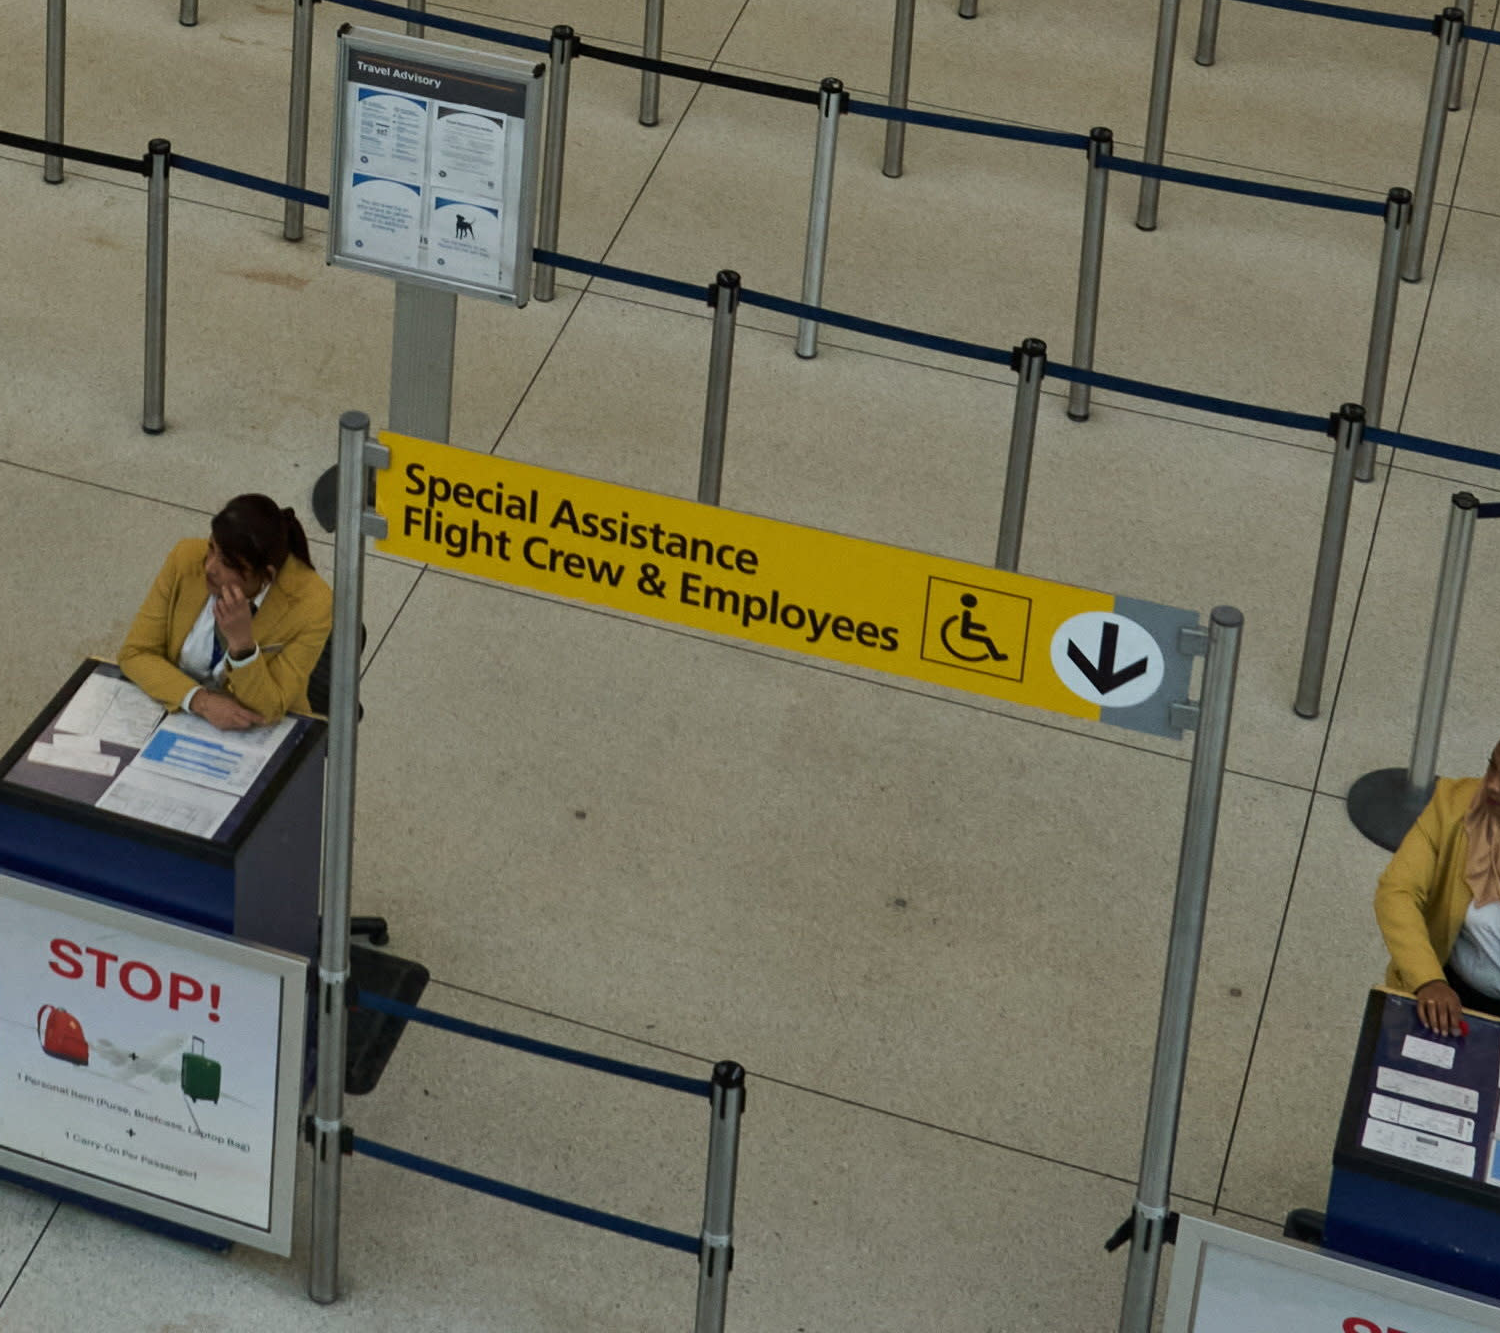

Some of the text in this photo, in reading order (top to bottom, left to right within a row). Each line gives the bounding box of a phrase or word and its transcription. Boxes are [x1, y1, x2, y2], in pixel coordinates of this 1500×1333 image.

[356, 59, 443, 90] Travel Advisory
[402, 460, 760, 579] Special Assistance
[401, 503, 900, 655] Flight Crew & Employees
[46, 935, 223, 1024] STOP!
[24, 1074, 69, 1096] Personal
[70, 1088, 95, 1105] Item
[72, 1133, 139, 1162] Carry-On Per
